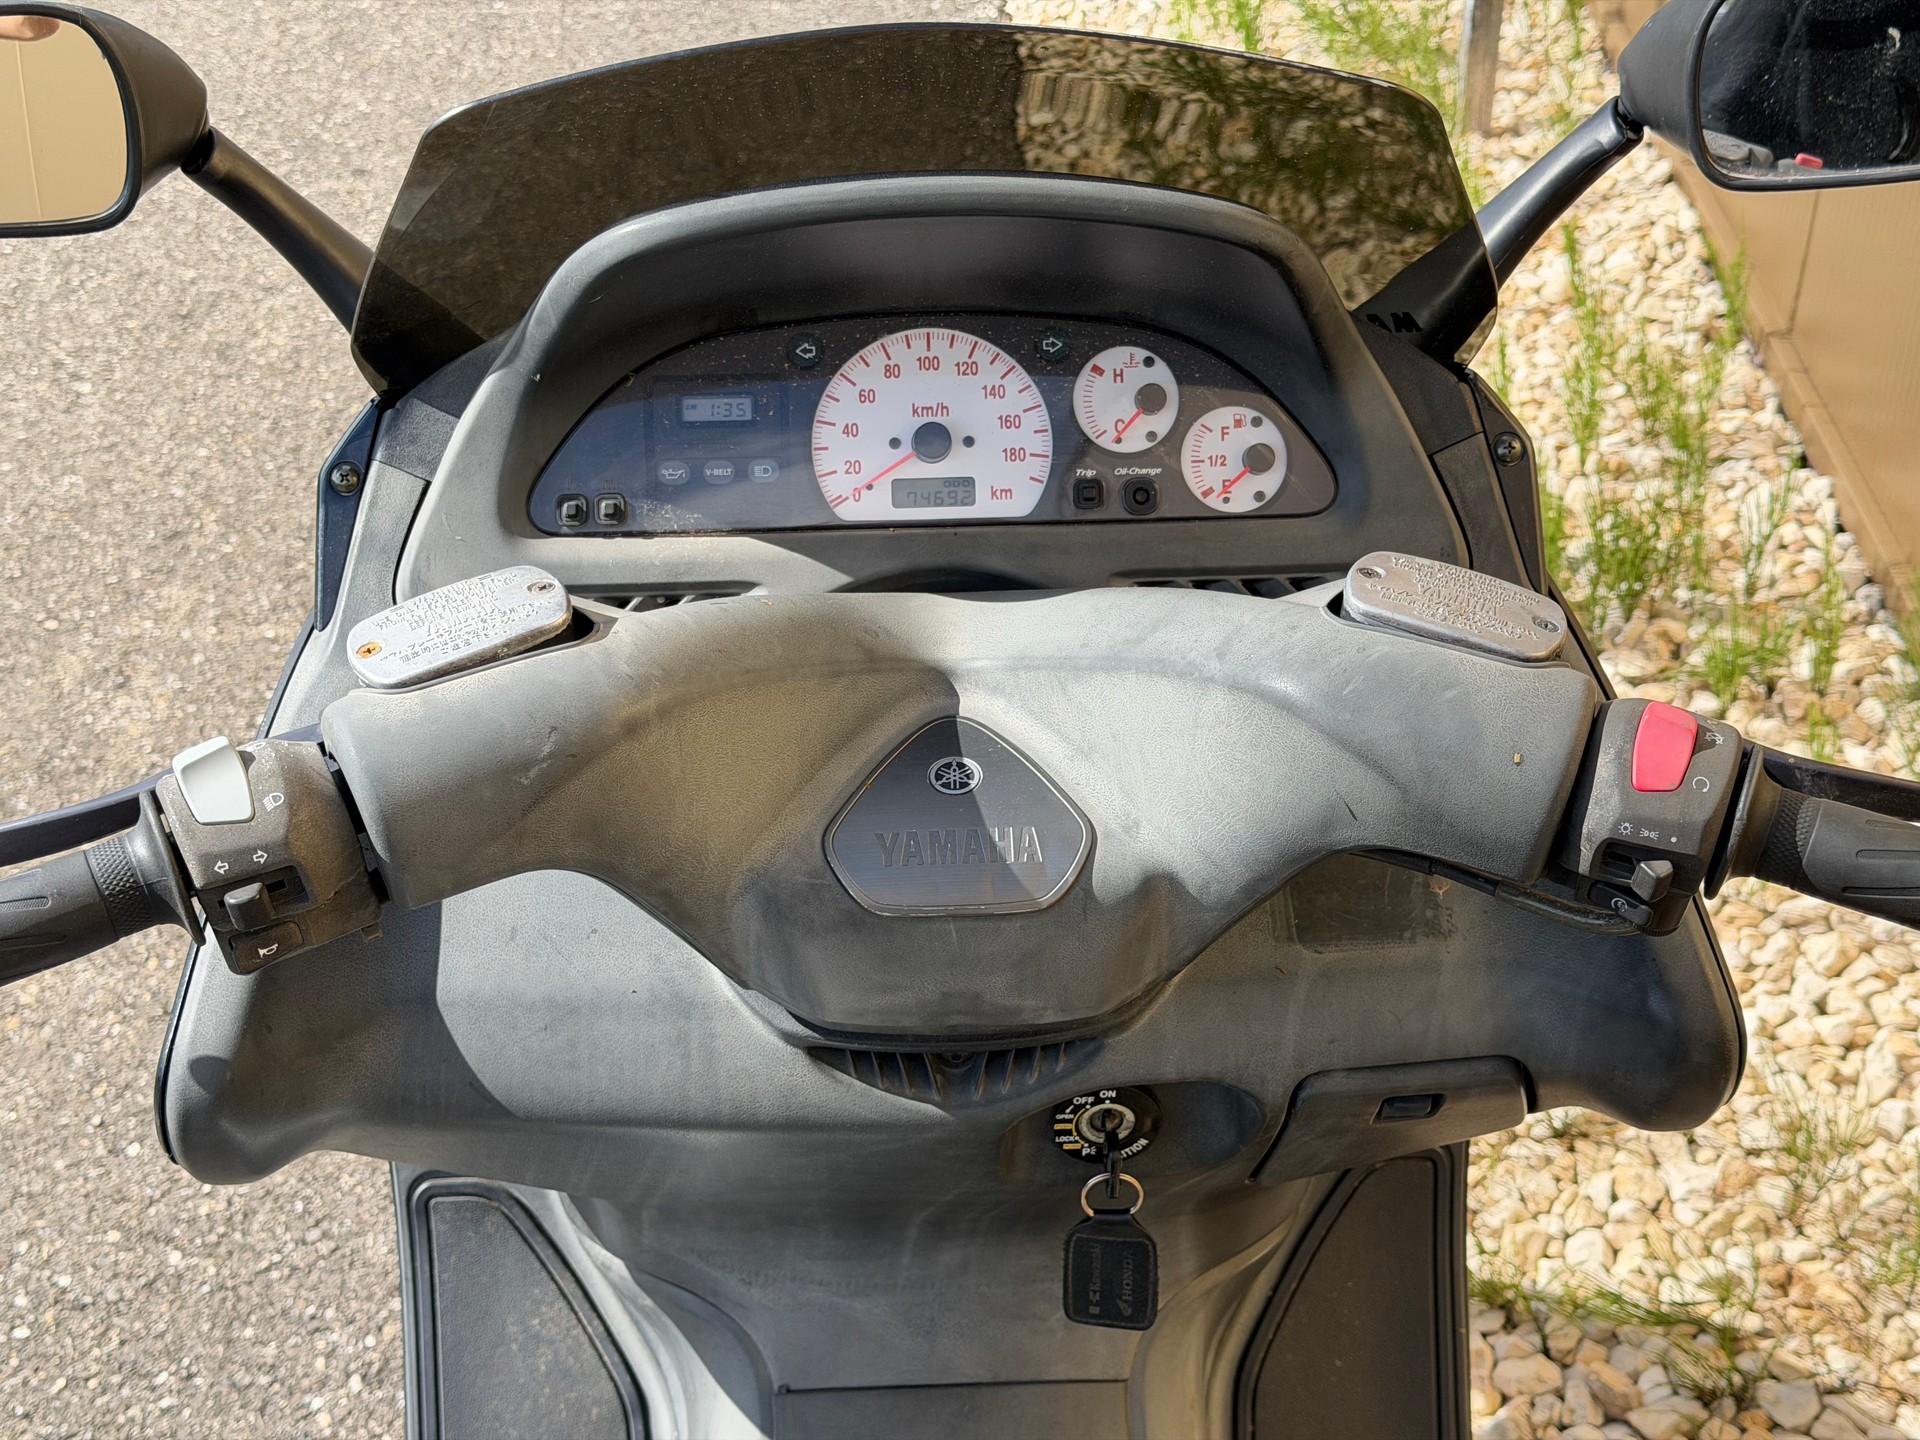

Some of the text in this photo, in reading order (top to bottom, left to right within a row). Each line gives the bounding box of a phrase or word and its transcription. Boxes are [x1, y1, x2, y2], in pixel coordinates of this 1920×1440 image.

[884, 363, 901, 379] 80
[916, 356, 940, 371] 100
[955, 361, 978, 377] 120
[1113, 368, 1124, 383] H
[858, 388, 876, 404] 60
[982, 384, 1006, 400] 140
[710, 402, 746, 417] 1:35
[912, 403, 949, 418] km/h
[997, 414, 1021, 430] 160
[1114, 419, 1126, 434] C
[842, 423, 859, 438] 40
[1221, 426, 1230, 441] F
[1002, 448, 1026, 462] 180
[1208, 454, 1227, 467] 1/2
[706, 468, 732, 476] V-BELT
[844, 460, 861, 475] 20
[1076, 469, 1096, 478] Trip
[1114, 466, 1162, 476] Oil-Change
[944, 480, 970, 488] ODO
[853, 488, 861, 503] 0
[907, 490, 972, 506] 74692
[990, 486, 1013, 500] km
[874, 827, 1043, 868] YAMAHA
[1100, 1090, 1116, 1098] ON
[1082, 1148, 1090, 1156] P
